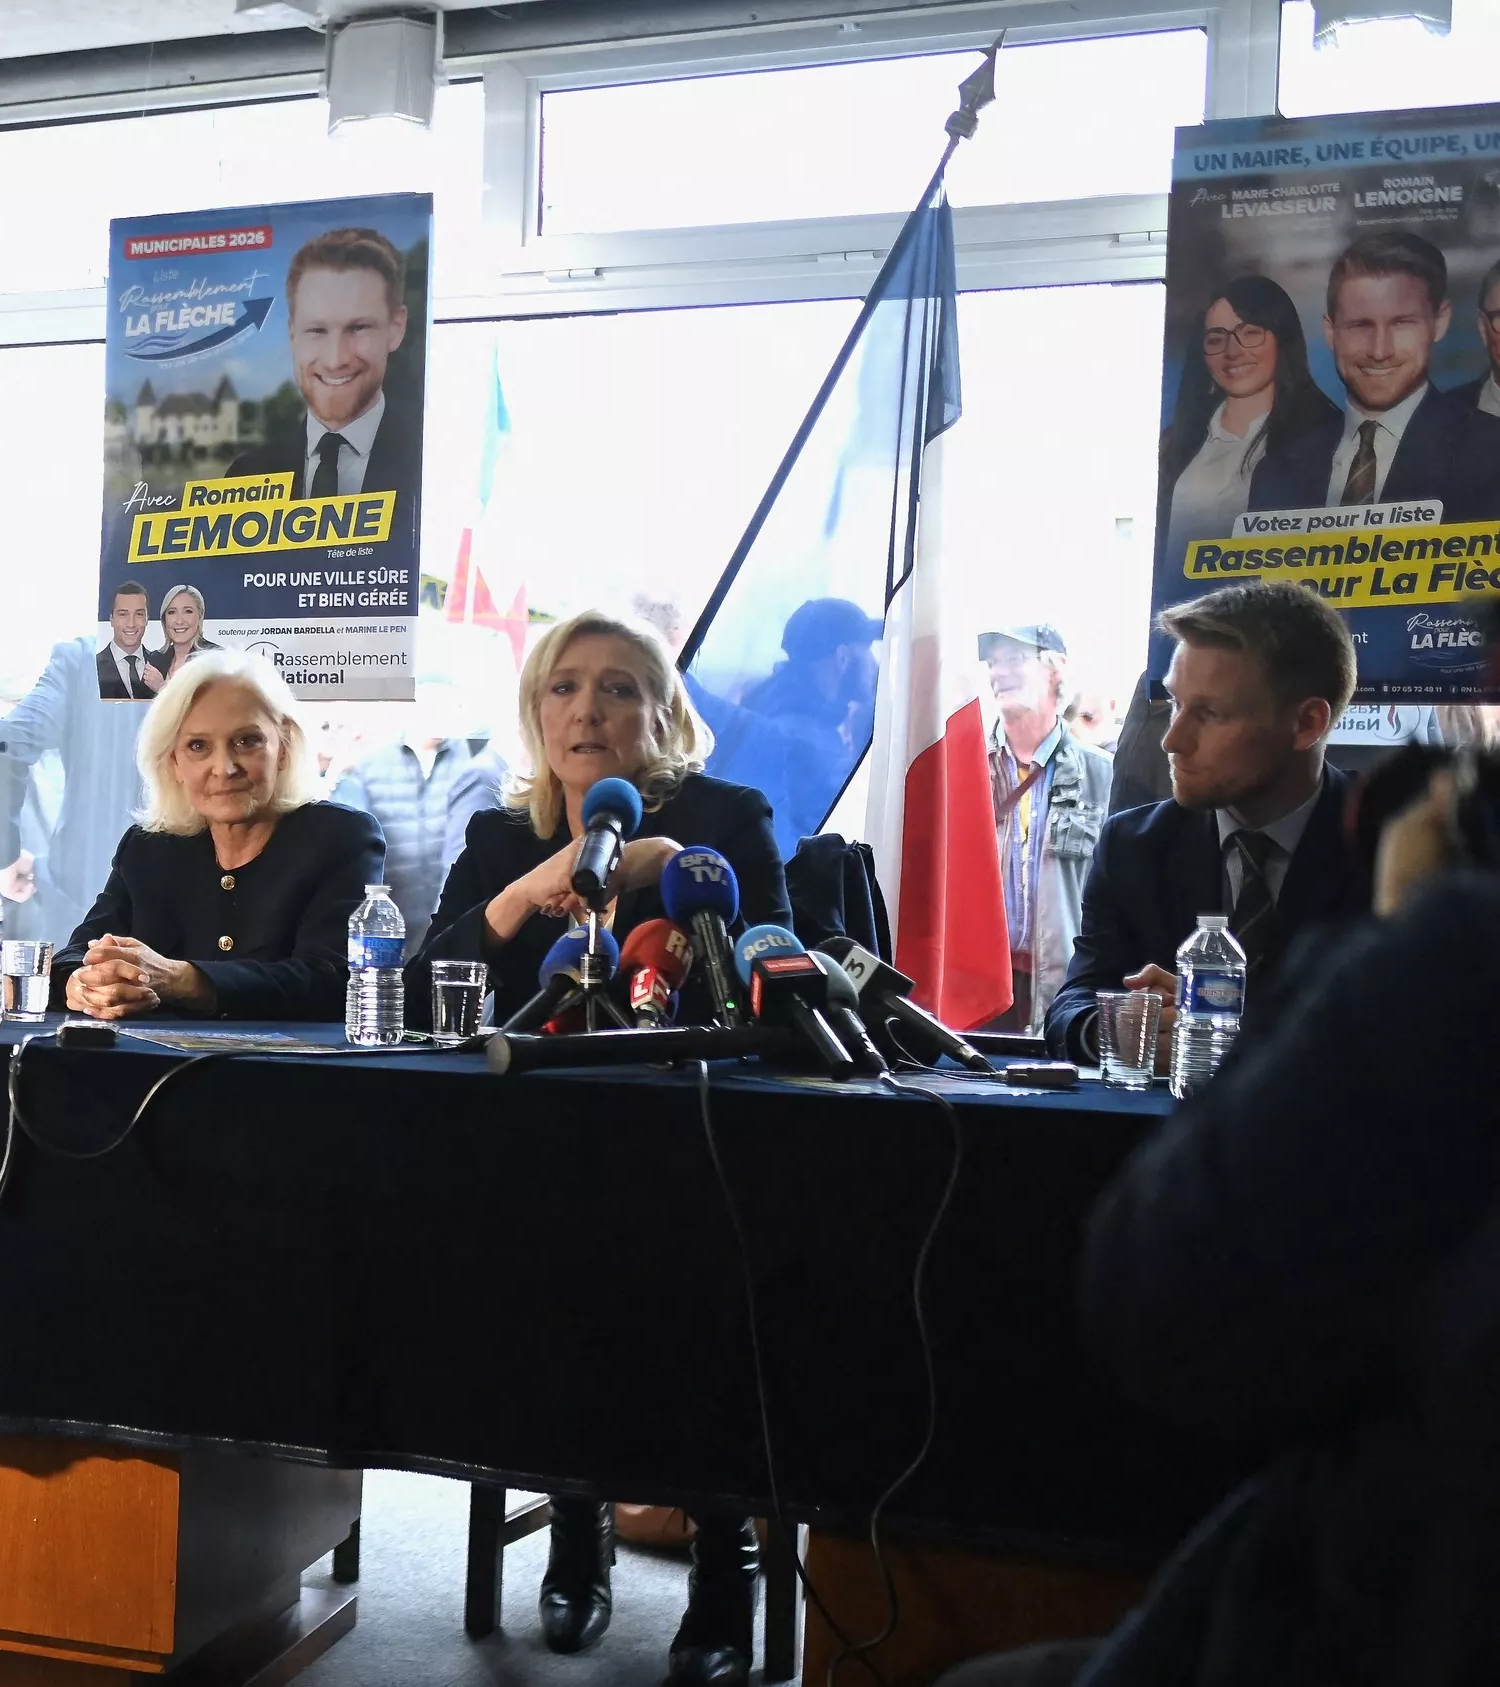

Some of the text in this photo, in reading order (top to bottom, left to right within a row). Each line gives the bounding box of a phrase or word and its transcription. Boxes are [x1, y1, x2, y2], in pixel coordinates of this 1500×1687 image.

[1193, 154, 1226, 172] UN
[1231, 146, 1311, 169] MAIRE,
[1316, 141, 1367, 162] UNE
[1369, 134, 1468, 159] ÉQUIPE,
[1383, 175, 1434, 189] ROMAIN
[1190, 182, 1341, 208] Avec MARIE-CHARLOTTE
[1354, 185, 1462, 208] LEMOIGNE
[1221, 196, 1336, 219] LEVASSEUR
[130, 231, 265, 255] MUNICIPALES 2026
[119, 269, 270, 313] Rassemblement
[125, 301, 237, 338] LA FLÈCHE
[122, 476, 285, 514] Avec Romain
[135, 499, 384, 557] LEMOIGNE
[1242, 505, 1436, 533] Votez pour la liste
[326, 546, 374, 559] Tête de liste
[243, 566, 409, 588] POUR UNE VILLE SÛRE
[1369, 567, 1418, 597] La
[298, 588, 408, 608] ET BIEN GÉRÉE
[218, 628, 246, 636] soutenu
[246, 628, 260, 637] par
[260, 627, 293, 635] JORDAN
[293, 626, 335, 635] BARDELLA
[345, 626, 377, 634] MARINE
[378, 625, 388, 633] LE
[389, 625, 407, 633] PEN
[1411, 633, 1434, 649] LA
[273, 650, 408, 666] Rassemblement
[281, 669, 345, 684] ational
[679, 853, 729, 871] BFM
